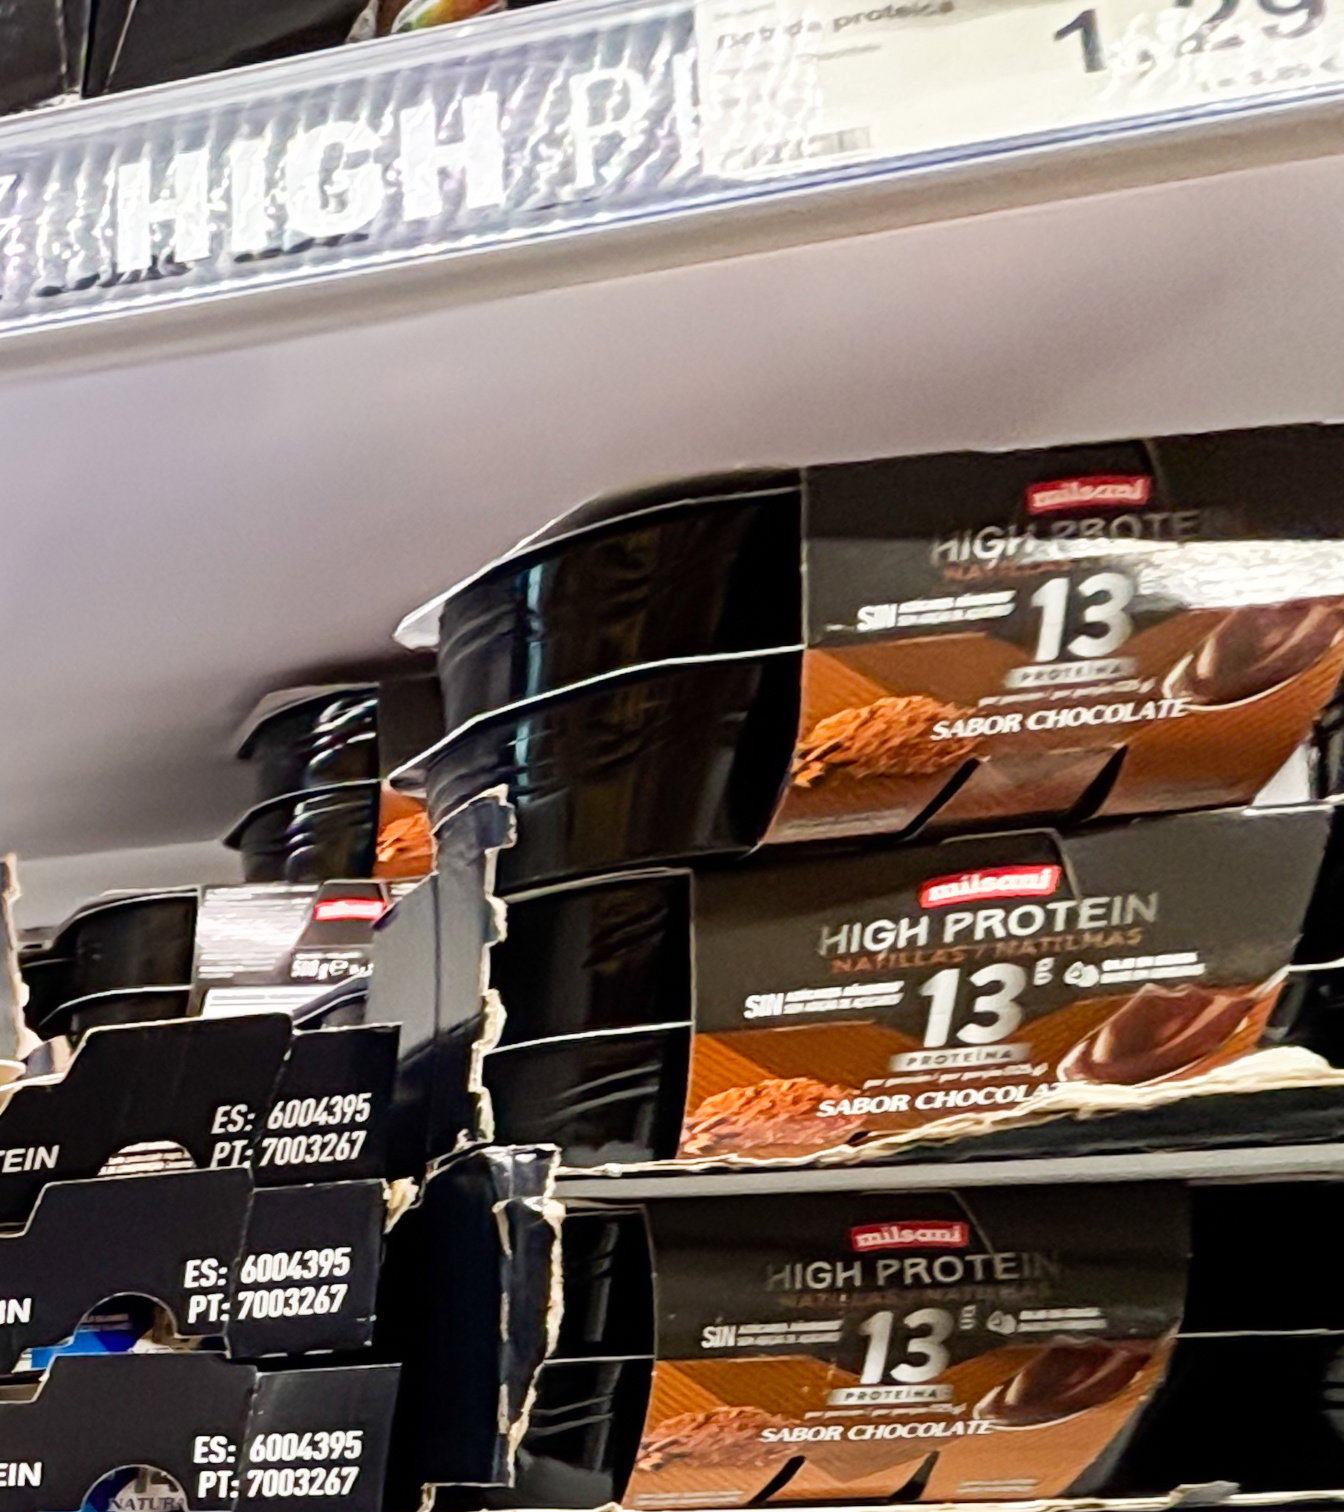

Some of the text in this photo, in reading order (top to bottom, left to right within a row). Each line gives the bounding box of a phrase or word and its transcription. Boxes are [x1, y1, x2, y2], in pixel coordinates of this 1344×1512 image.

[117, 92, 508, 273] HIGH
[1031, 573, 1135, 663] 13
[931, 696, 1193, 741] SABOR CHOCOLATE
[818, 891, 1159, 958] HIGH PROTEIN
[921, 963, 1028, 1048] 13
[213, 1093, 372, 1133] ES: 6004395
[817, 1089, 909, 1117] SABOR
[261, 1131, 366, 1166] 7003267
[184, 1248, 350, 1288] ES: 6004395
[877, 1253, 1059, 1287] PROTEIN
[188, 1284, 348, 1324] PT: 7003267
[856, 1308, 954, 1386] 13
[194, 1431, 363, 1464] ES: 6004395
[762, 1418, 996, 1443] SABOR CHOCOLATE
[198, 1466, 359, 1500] PT: 7003267
